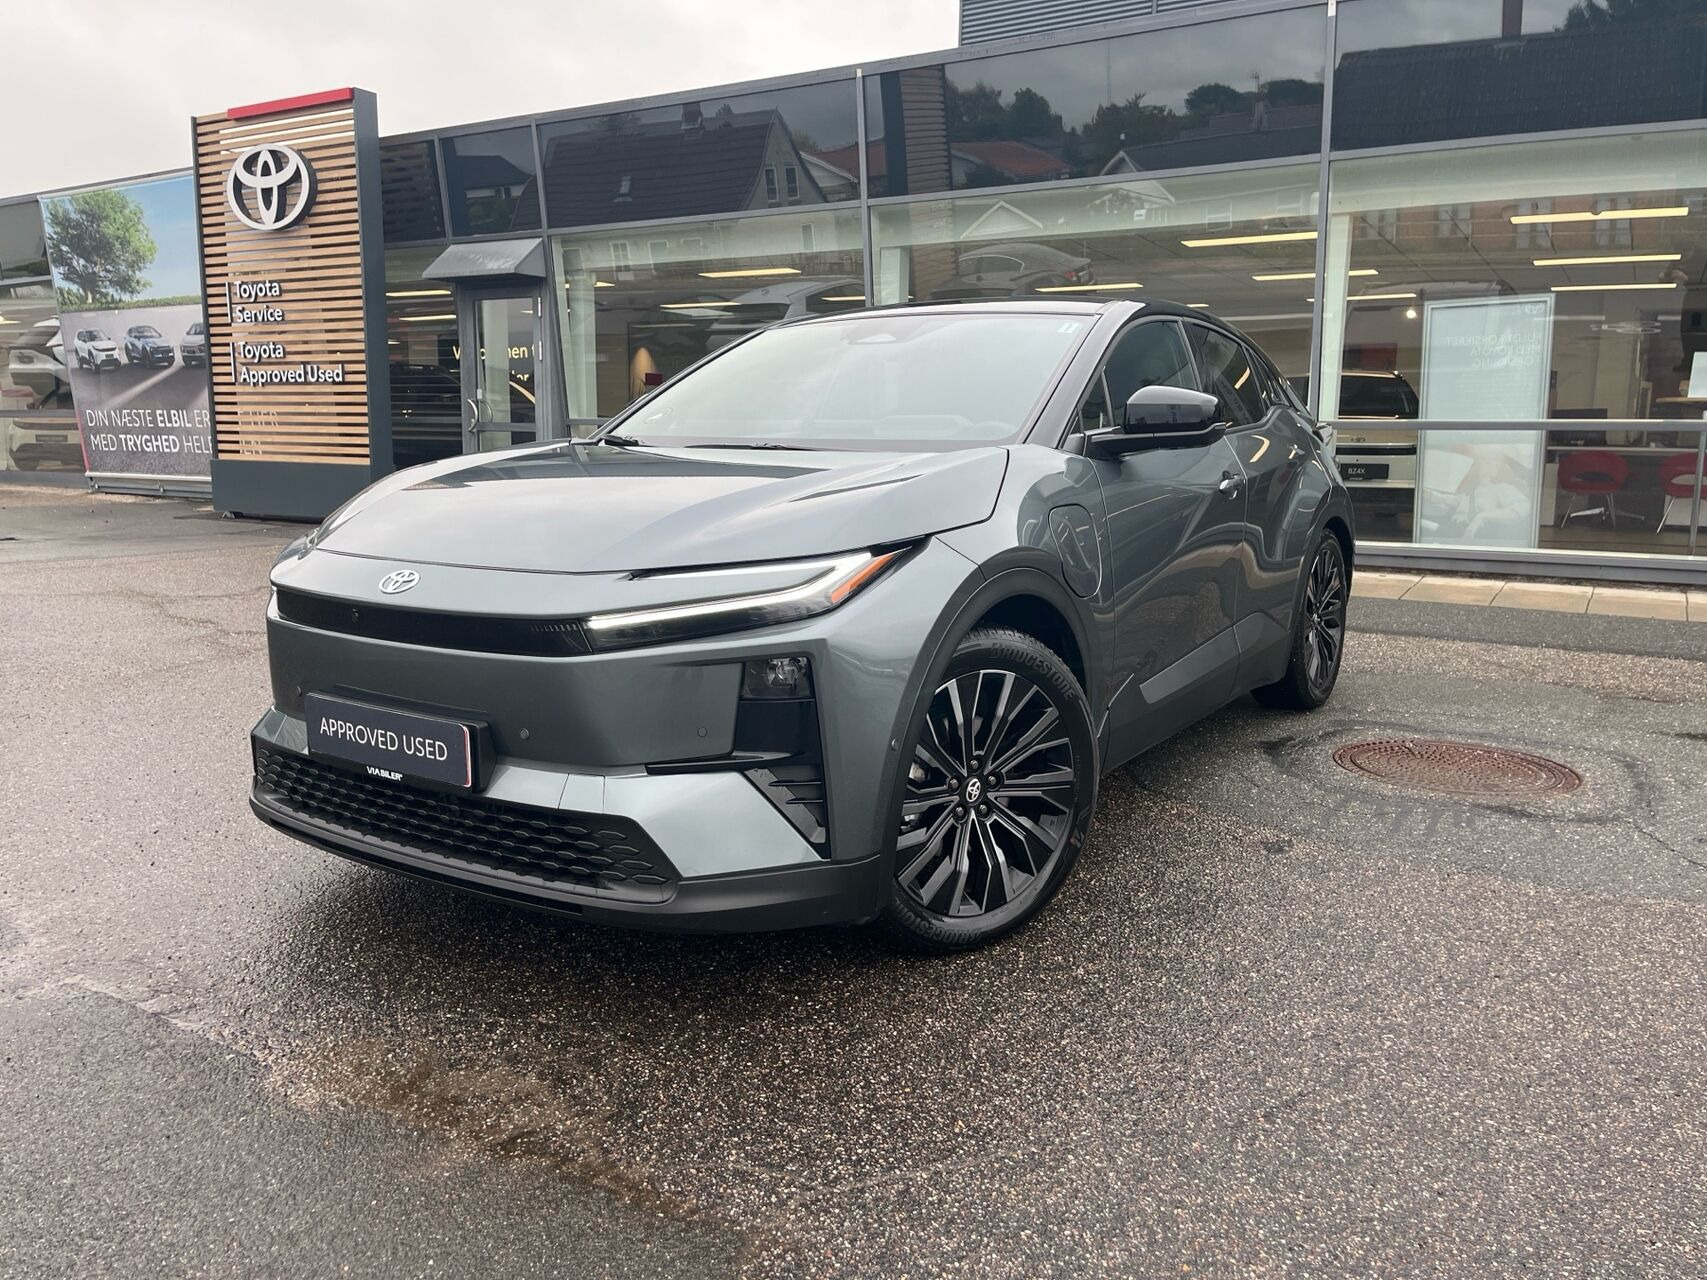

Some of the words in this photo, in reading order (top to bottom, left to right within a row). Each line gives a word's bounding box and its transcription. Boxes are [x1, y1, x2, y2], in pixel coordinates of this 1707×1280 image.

[234, 280, 280, 302] Toyota
[236, 305, 283, 323] Service
[238, 341, 284, 363] Toyota
[240, 364, 305, 387] Approved
[308, 364, 343, 383] Used
[86, 409, 109, 427] DIN
[111, 409, 154, 427] NÆSTE
[156, 409, 192, 428] ELBIL
[90, 433, 118, 451] MED
[119, 434, 180, 453] TRYGHED
[986, 642, 1076, 701] BRIDGESTONE
[319, 717, 399, 751] APPROVED
[402, 734, 448, 761] USED
